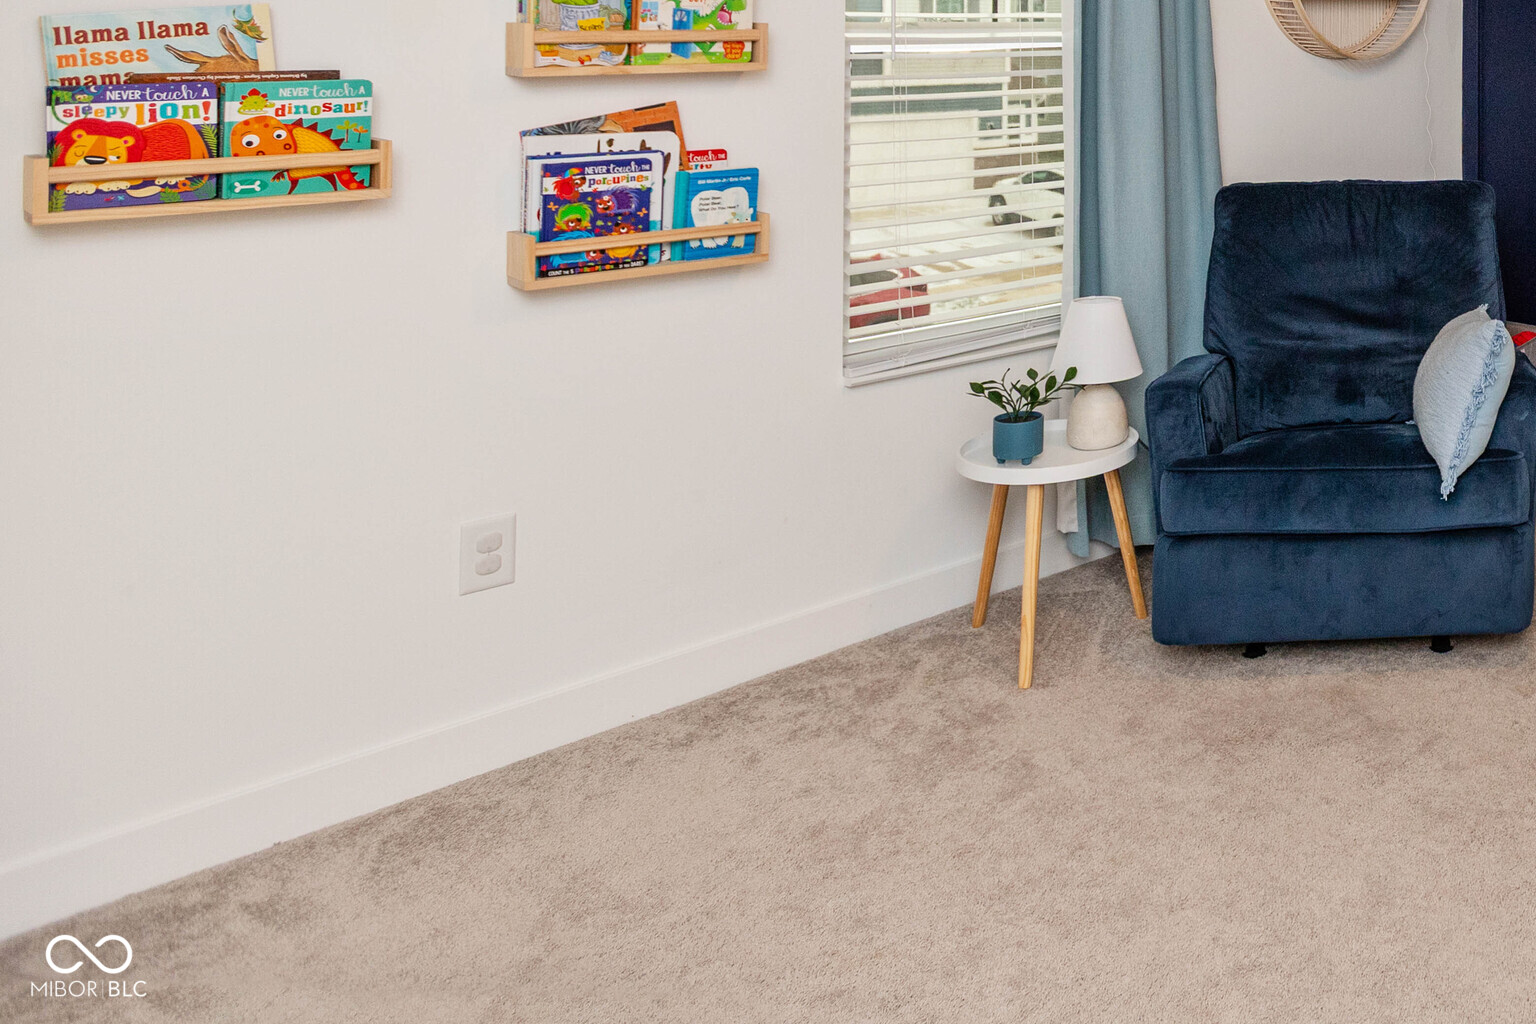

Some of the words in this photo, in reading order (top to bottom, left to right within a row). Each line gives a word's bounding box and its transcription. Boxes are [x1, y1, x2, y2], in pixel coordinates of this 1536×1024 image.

[52, 25, 130, 46] llama
[136, 20, 211, 41] llama
[56, 47, 150, 69] misses
[106, 89, 142, 101] NEVER
[142, 84, 198, 101] touch
[201, 87, 210, 97] A
[278, 87, 309, 97] NEVER
[309, 82, 358, 97] touch
[358, 85, 366, 95] A
[62, 104, 130, 119] sleepy
[135, 100, 212, 126] lion!
[274, 100, 369, 117] dinosaur!
[688, 150, 718, 163] touch
[584, 165, 608, 175] NEVER
[608, 161, 640, 174] touch
[588, 174, 649, 188] porcupines
